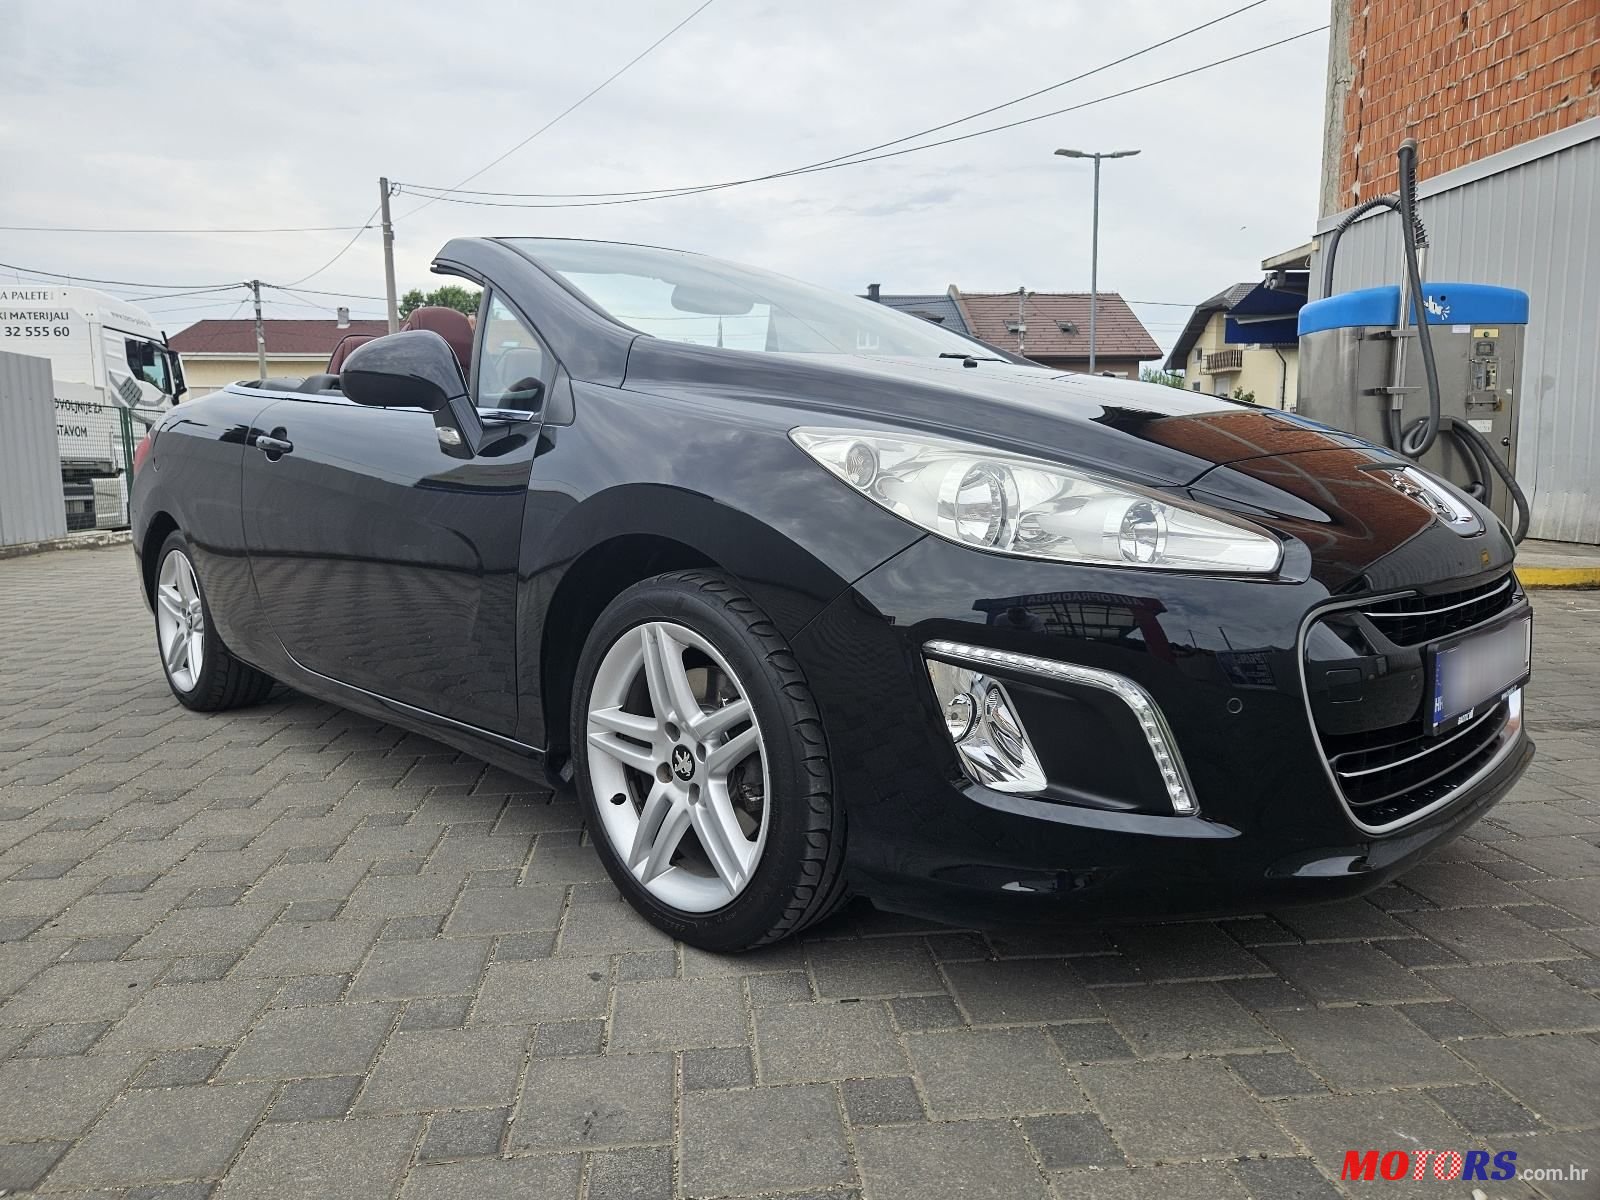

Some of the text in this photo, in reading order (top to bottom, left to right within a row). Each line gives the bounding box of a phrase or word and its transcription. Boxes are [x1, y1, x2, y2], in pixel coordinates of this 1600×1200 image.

[11, 290, 49, 300] PALETE
[10, 312, 69, 322] MATERIJALI
[4, 326, 70, 337] 32 555 60
